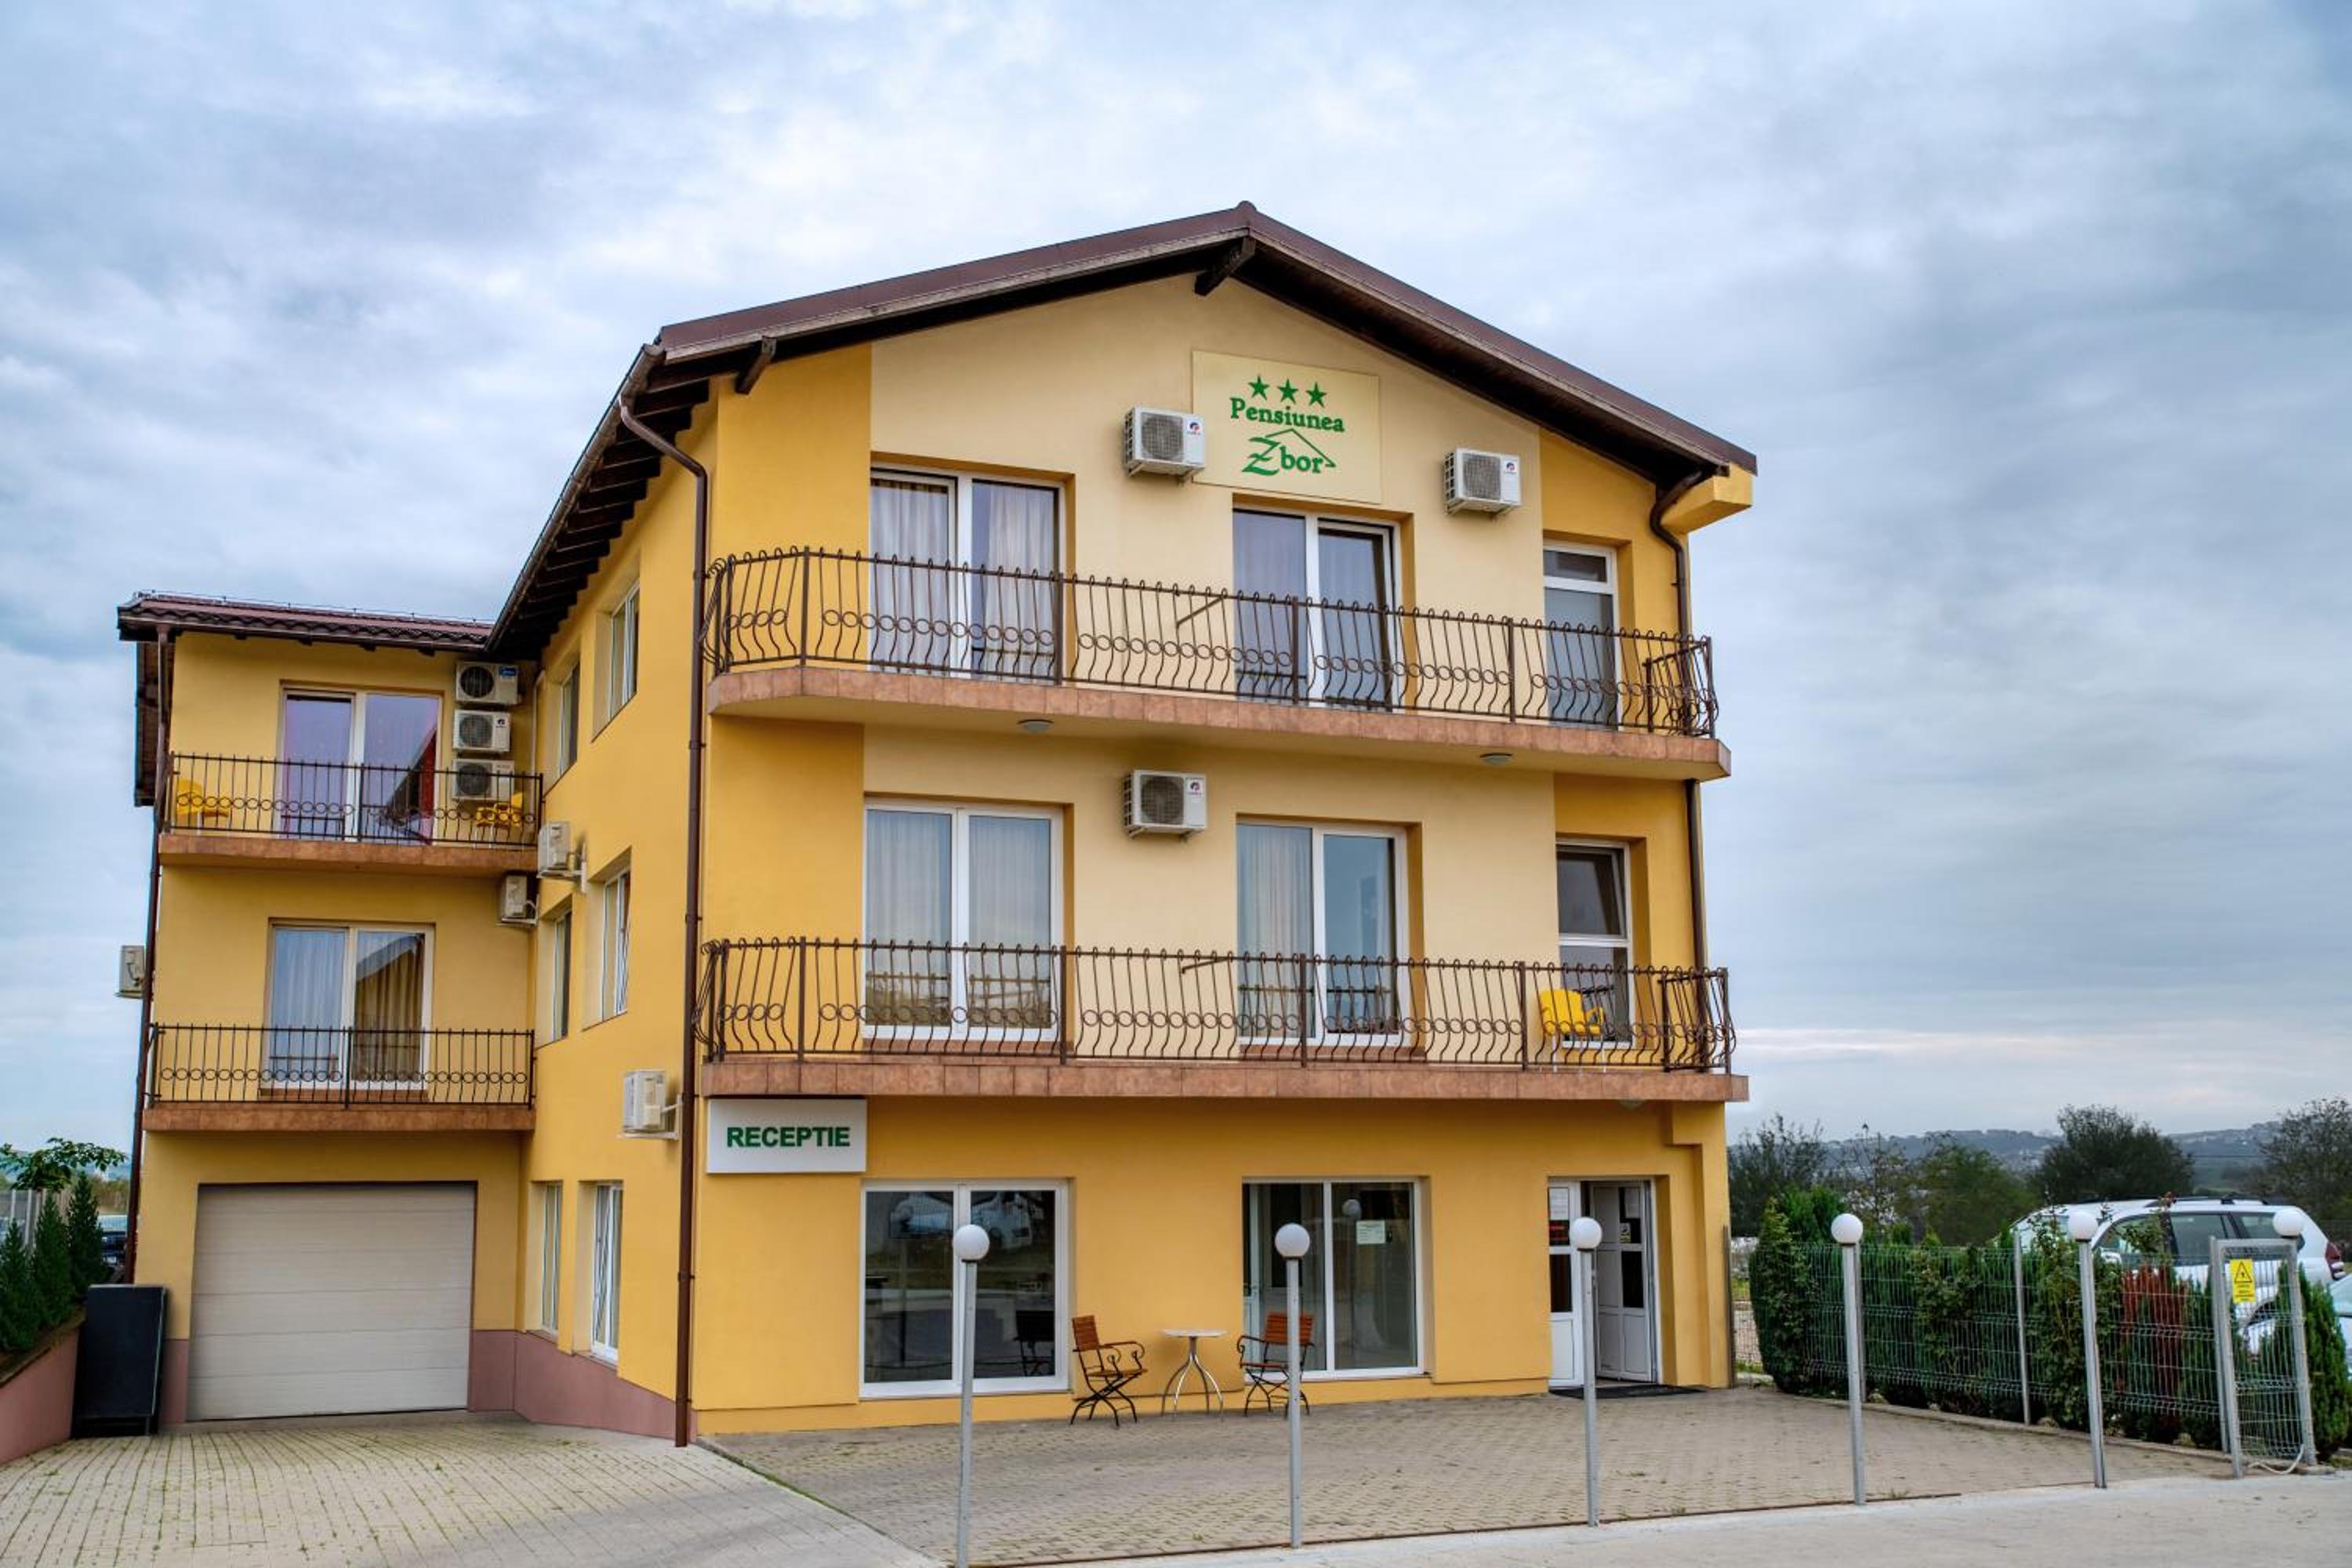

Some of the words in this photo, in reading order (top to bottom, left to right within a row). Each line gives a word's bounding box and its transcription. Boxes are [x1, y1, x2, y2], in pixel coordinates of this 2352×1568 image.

[1230, 397, 1345, 431] Pensiunea
[1242, 437, 1323, 476] Zbor
[727, 1127, 850, 1147] RECEPTIE
